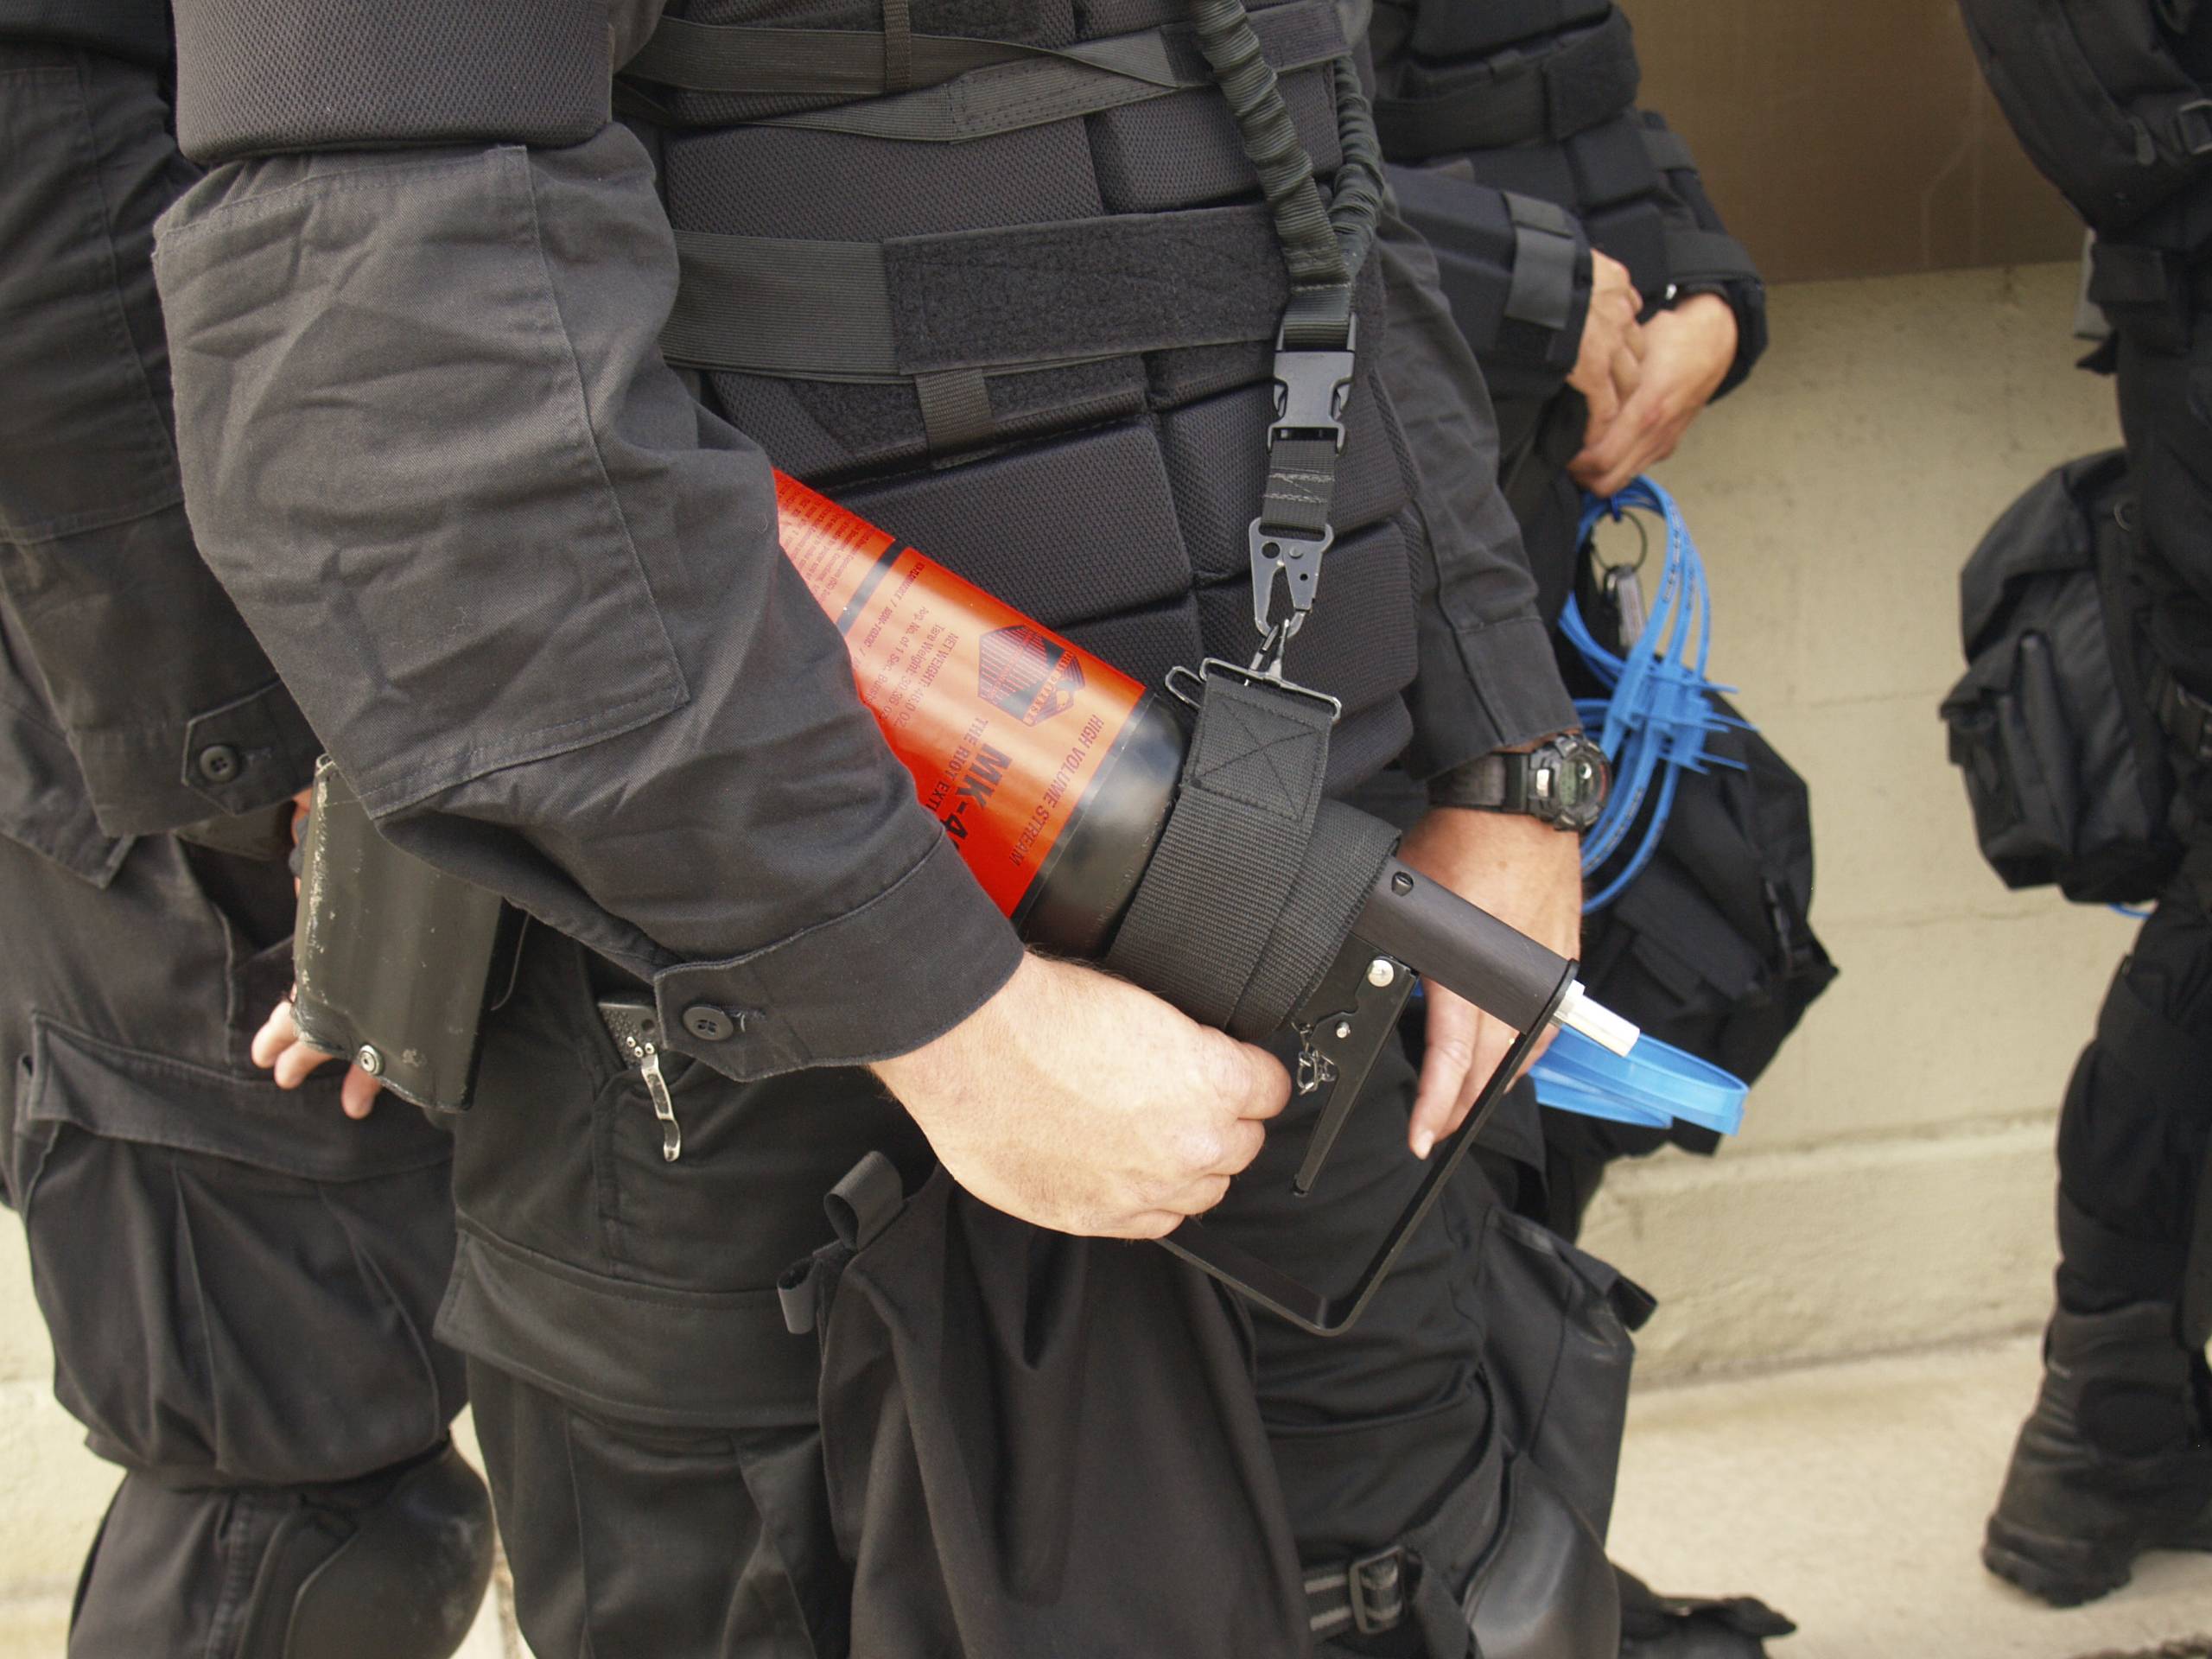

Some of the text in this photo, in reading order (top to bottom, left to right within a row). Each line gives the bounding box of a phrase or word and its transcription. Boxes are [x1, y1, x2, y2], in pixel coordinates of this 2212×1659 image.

[940, 631, 959, 651] NET
[925, 715, 988, 812] THE RIOT EXTI
[939, 742, 1013, 851] MK-4
[1007, 714, 1104, 868] HIGH VOLUME STREAM
